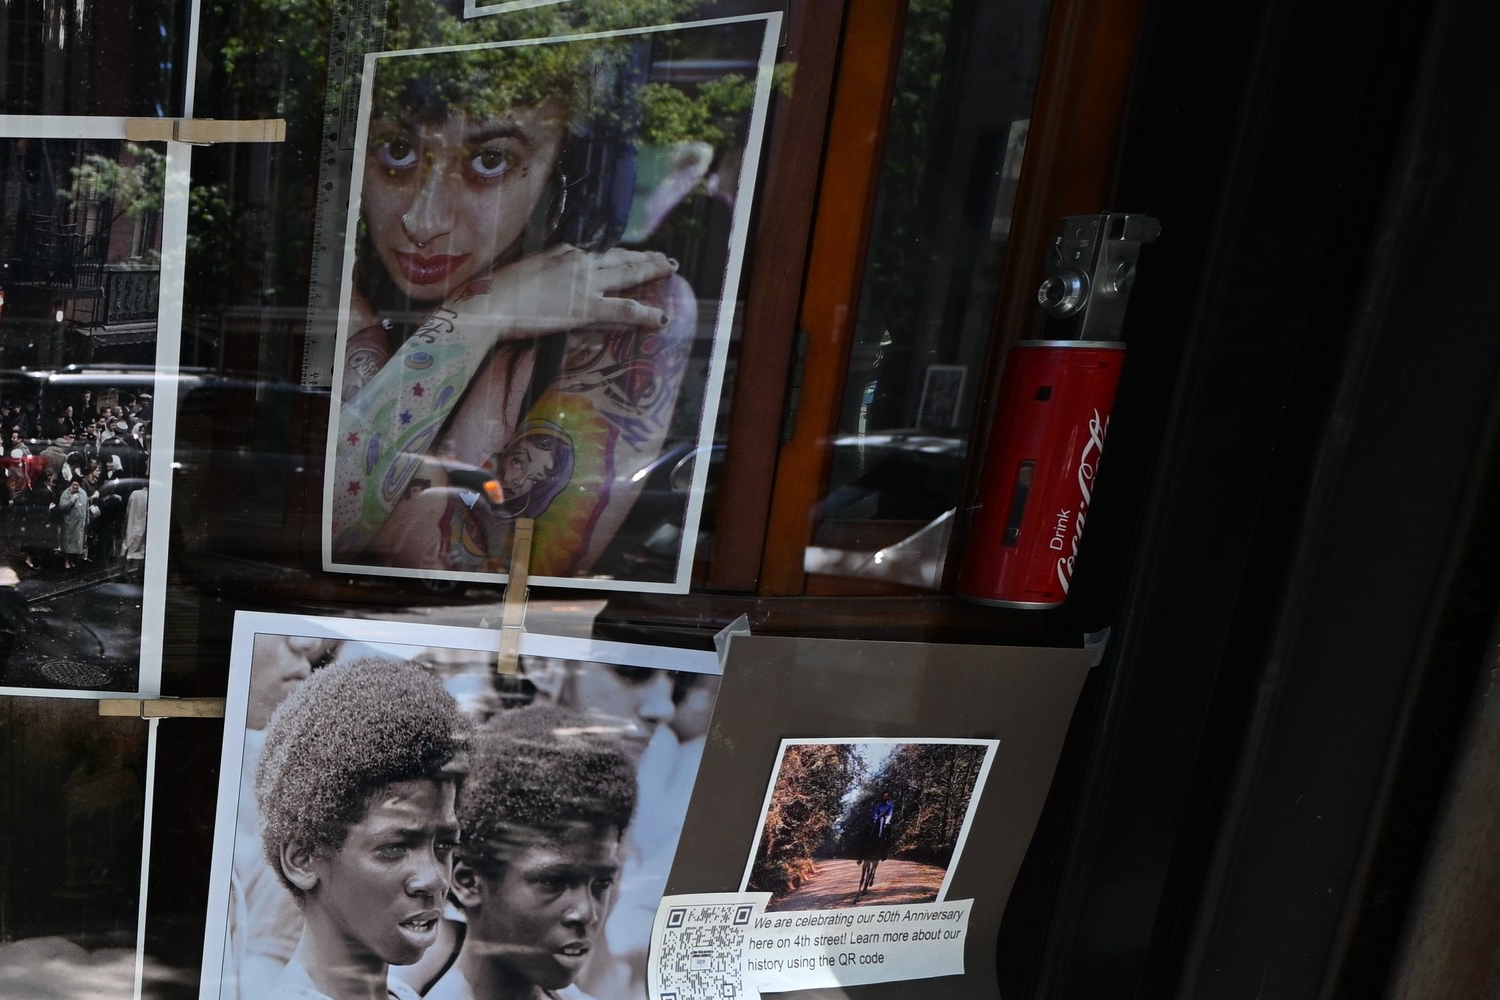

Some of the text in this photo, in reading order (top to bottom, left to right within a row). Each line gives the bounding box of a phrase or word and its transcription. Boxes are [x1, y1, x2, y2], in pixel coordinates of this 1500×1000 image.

[1049, 507, 1070, 551] Drink
[754, 907, 964, 932] We are celebrating our 50th Anniversary
[749, 927, 961, 950] here on 4th street! Learn more about our
[747, 951, 884, 973] history using the QR code
